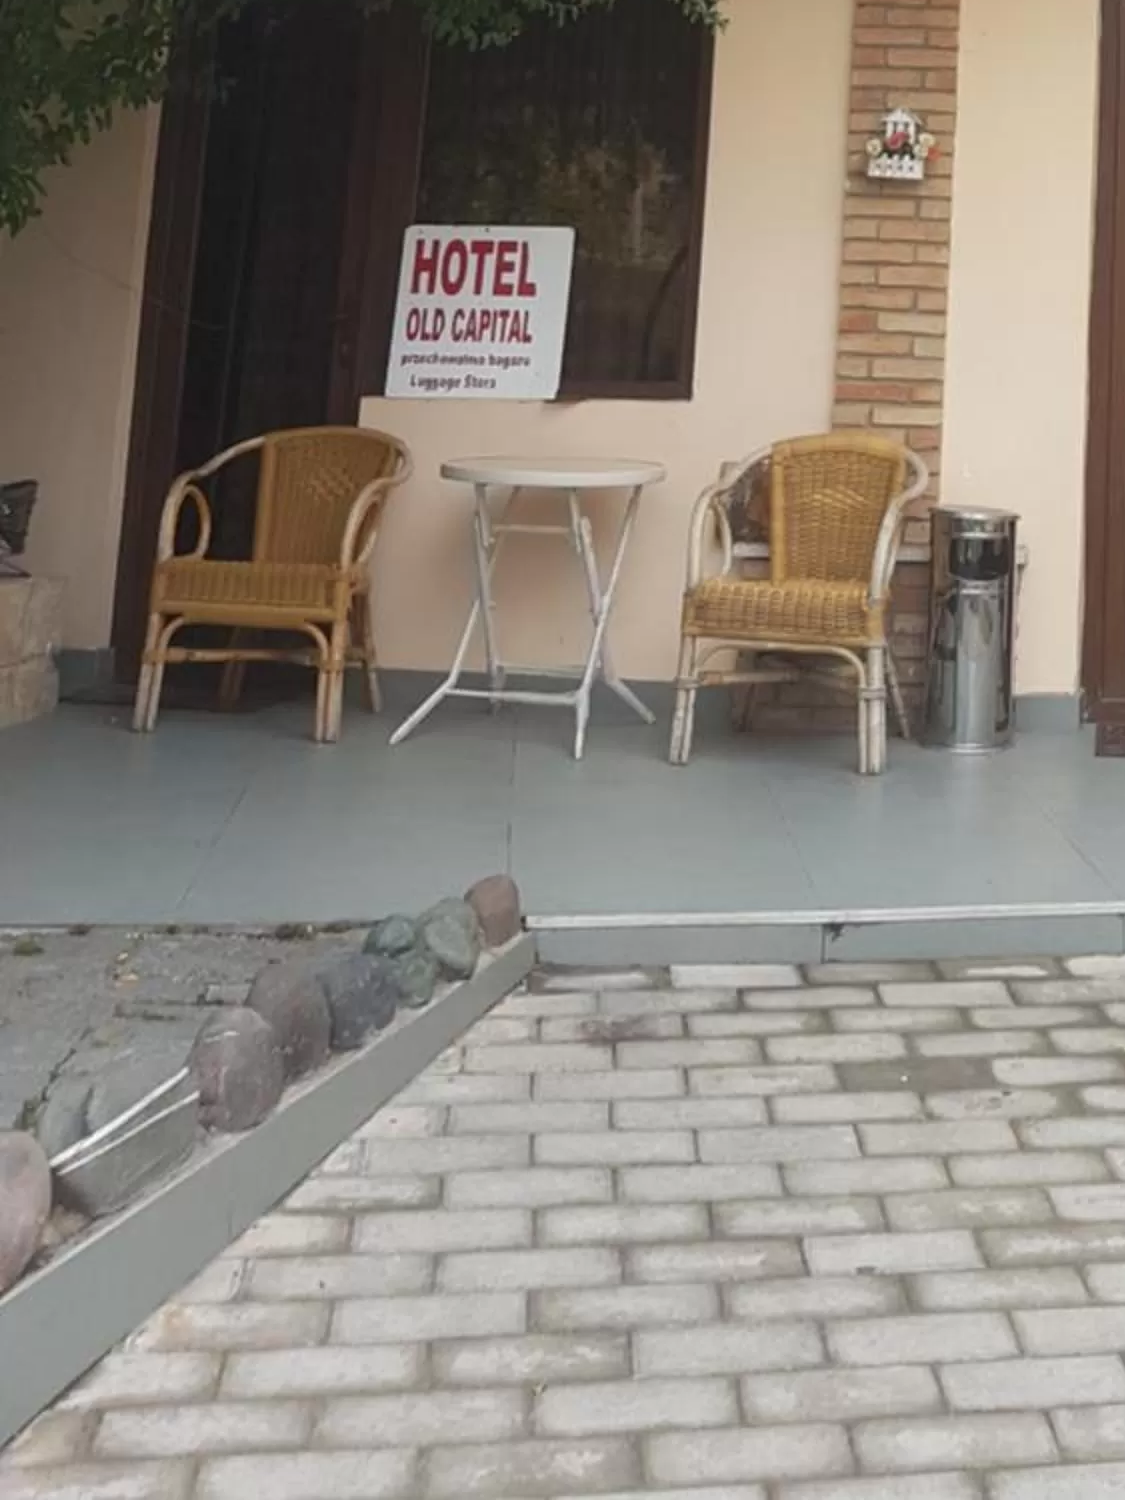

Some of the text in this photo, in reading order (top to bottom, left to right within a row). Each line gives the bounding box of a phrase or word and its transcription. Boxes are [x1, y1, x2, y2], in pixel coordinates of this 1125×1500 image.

[410, 238, 537, 297] HOTEL
[406, 307, 533, 344] OLD CAPITAL
